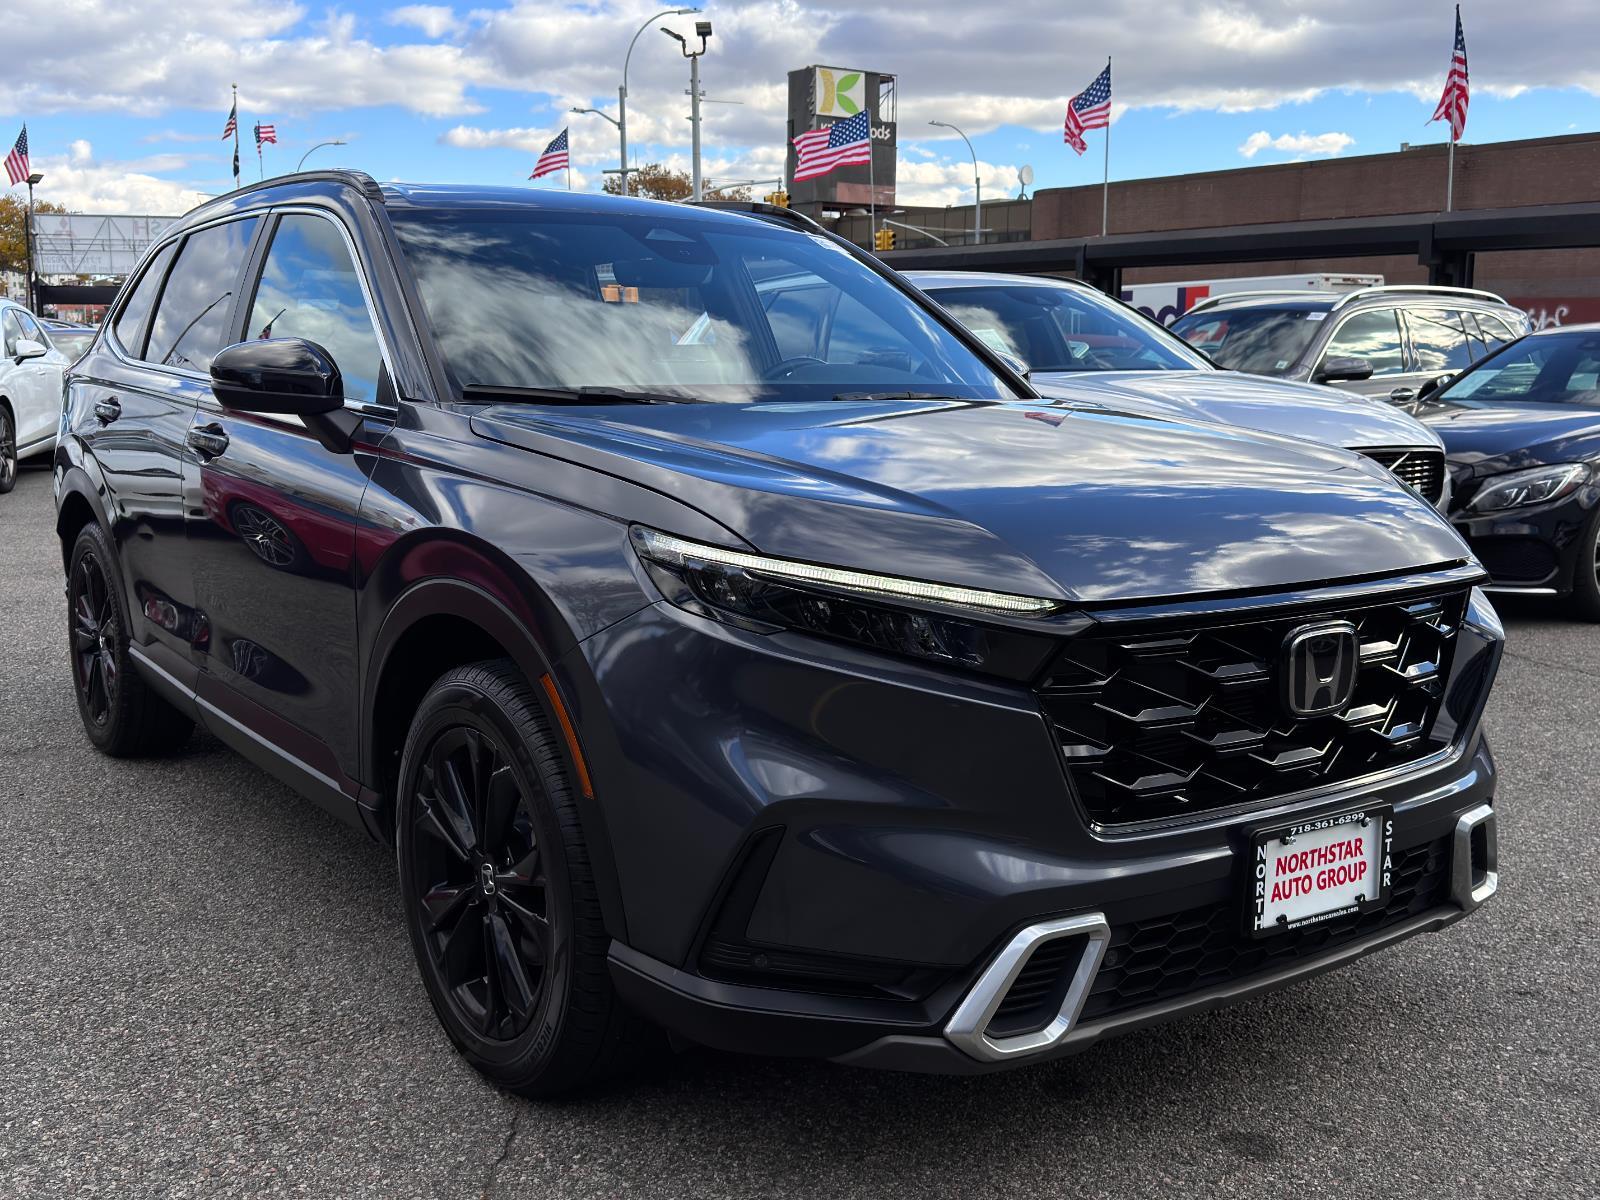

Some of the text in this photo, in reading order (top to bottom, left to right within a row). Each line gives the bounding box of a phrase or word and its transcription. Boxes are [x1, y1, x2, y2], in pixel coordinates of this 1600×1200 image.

[1290, 812, 1365, 836] 718-361-6299
[1275, 837, 1364, 877] NORTHSTAR
[1383, 820, 1393, 887] STAR
[1254, 844, 1267, 931] NORTH
[1270, 860, 1367, 903] AUTO GROUP
